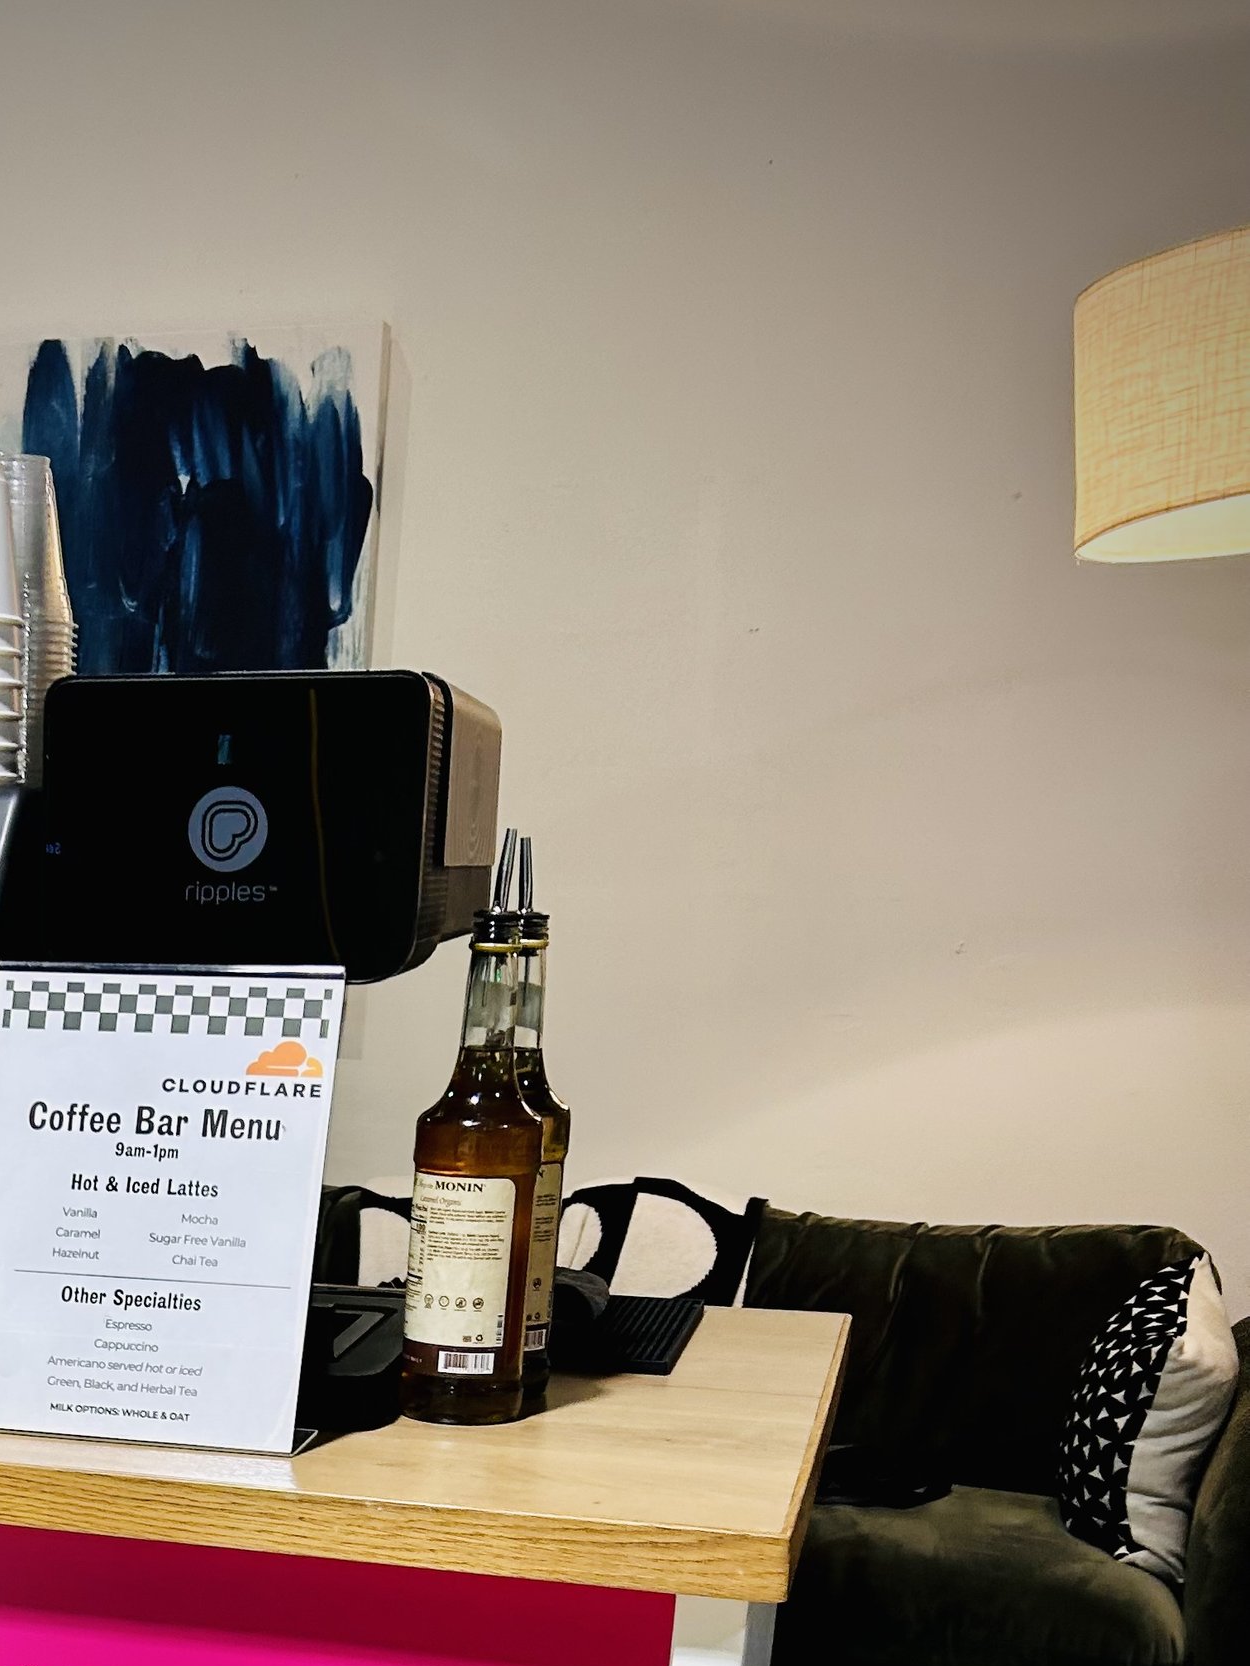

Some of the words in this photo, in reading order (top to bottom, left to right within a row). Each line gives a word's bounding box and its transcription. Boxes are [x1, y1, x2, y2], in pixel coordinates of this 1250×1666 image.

[185, 881, 266, 905] ripples
[161, 1078, 322, 1098] CLOUDFLARE
[29, 1101, 121, 1134] Coffee
[135, 1105, 189, 1137] Bar
[201, 1108, 281, 1141] Menu
[115, 1142, 179, 1162] 9am-1pm
[71, 1173, 98, 1191] Hot
[105, 1176, 118, 1192] &
[126, 1176, 161, 1194] Iced
[167, 1178, 219, 1198] Lattes
[435, 1181, 483, 1192] MONIN
[63, 1206, 98, 1219] Vanilla
[181, 1213, 219, 1226] Mocha
[55, 1227, 101, 1239] Caramel
[149, 1232, 181, 1246] Sugar
[183, 1234, 208, 1246] Free
[210, 1236, 247, 1248] Vanilla
[52, 1247, 100, 1260] Hazelnut
[172, 1254, 197, 1266] Chai
[199, 1256, 218, 1267] Tea
[61, 1286, 106, 1305] Other
[113, 1289, 201, 1311] Specialties
[105, 1318, 153, 1332] Espresso
[94, 1338, 159, 1353] Cappuccino
[47, 1355, 106, 1369] Americano
[107, 1360, 143, 1373] served
[145, 1363, 165, 1374] hot
[165, 1365, 177, 1375] or
[178, 1365, 203, 1377] iced
[47, 1375, 82, 1389] Green,
[84, 1378, 115, 1392] Black,
[116, 1382, 139, 1393] and
[140, 1384, 177, 1396] Herbal
[179, 1386, 198, 1397] Tea
[50, 1402, 73, 1413] MILK
[74, 1404, 119, 1416] OPTIONS:
[121, 1408, 158, 1420] WHOLE
[160, 1411, 168, 1420] &
[169, 1412, 191, 1422] OAT
